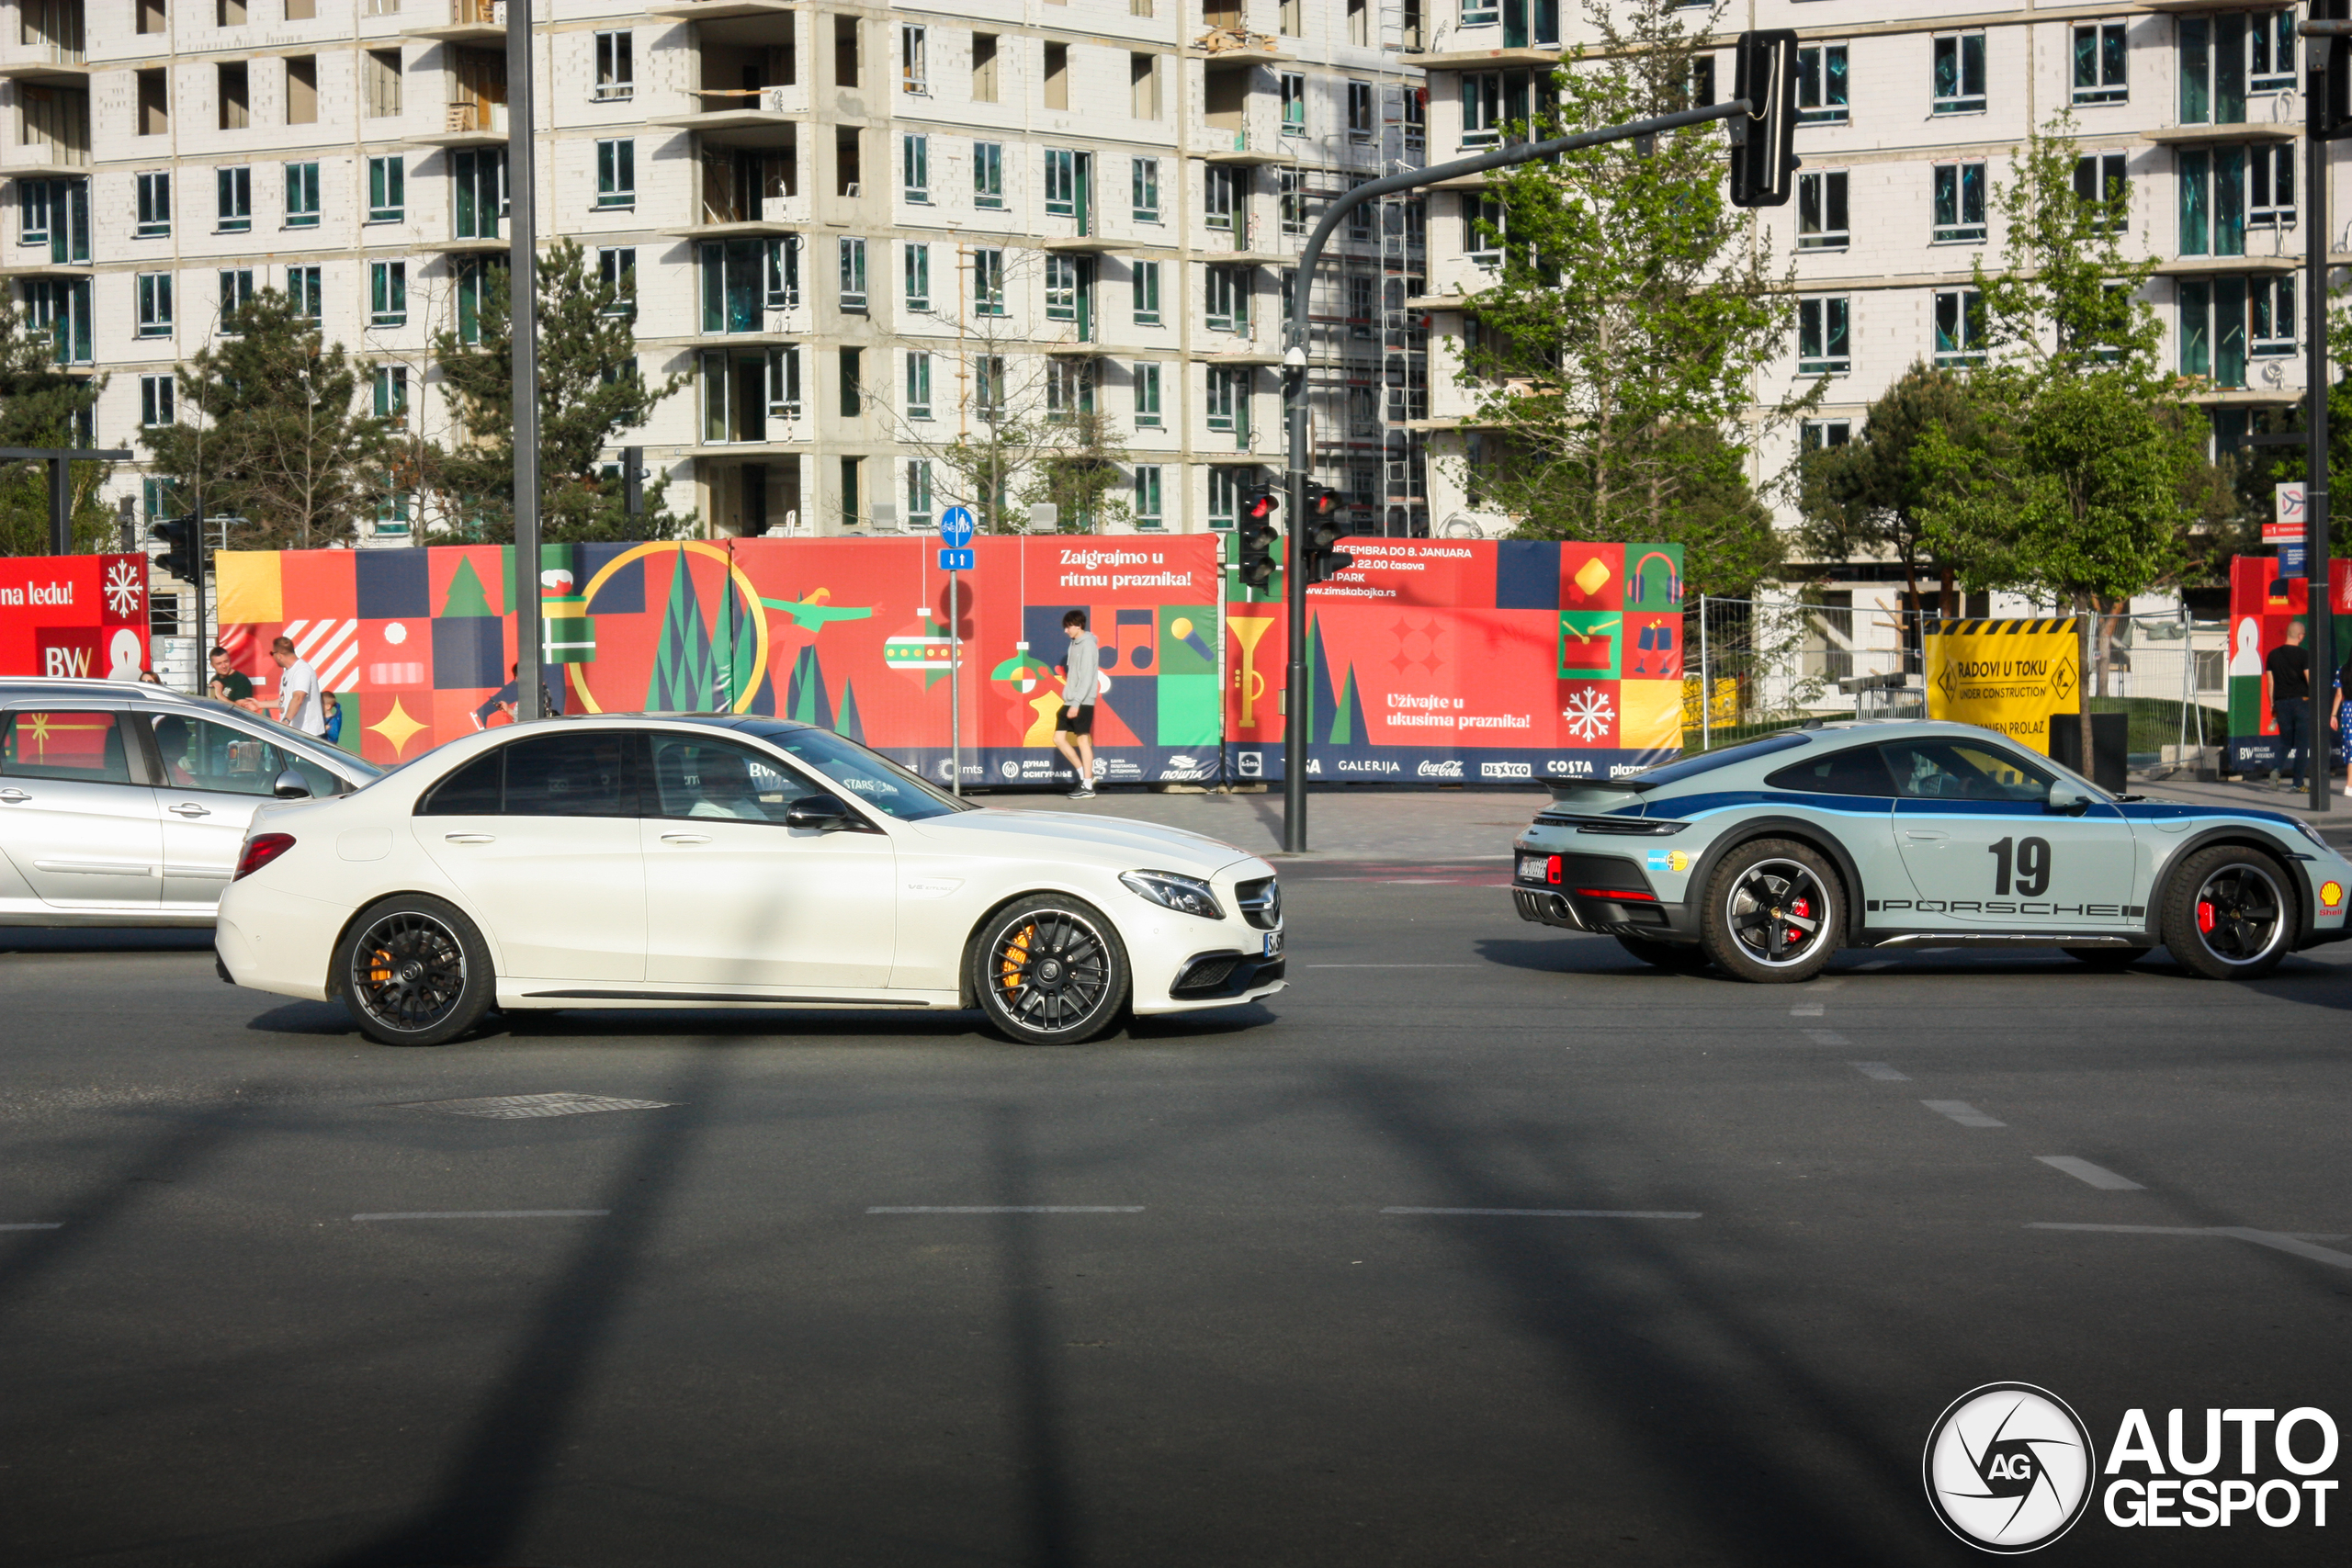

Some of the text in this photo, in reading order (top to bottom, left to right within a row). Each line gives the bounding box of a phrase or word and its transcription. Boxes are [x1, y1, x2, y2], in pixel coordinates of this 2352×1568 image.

[1060, 549, 1163, 570] Zaigrajmo u
[1389, 547, 1406, 557] DO
[1407, 547, 1418, 557] 8.
[1419, 547, 1473, 558] JANUARA
[1357, 559, 1388, 569] 22.00
[1389, 560, 1425, 570] časova
[1060, 571, 1192, 590] ritmu praznika!
[1337, 573, 1365, 581] PARK
[1, 581, 74, 605] na ledu!
[1306, 586, 1396, 599] ww.zimskabajka.rs
[45, 647, 92, 678] BW
[1958, 660, 2047, 678] RADOVI U TOKU
[1959, 686, 2047, 700] UNDER CONSTRUCTION
[1386, 694, 1464, 711] Uživajte u
[1386, 712, 1531, 730] ukusima praznika!
[1974, 720, 2044, 735] ANJEN PROLAZ
[962, 764, 983, 774] mts
[1022, 760, 1050, 769] ДУНАВ
[1338, 760, 1401, 773] GALERIJA
[1483, 762, 1530, 778] DEXYCO
[1546, 760, 1594, 774] COSTA
[1159, 770, 1204, 780] ПОШТА
[843, 778, 875, 792] STARS
[1988, 836, 2051, 897] 19
[1883, 899, 2120, 918] PORSCHE
[2319, 908, 2342, 917] Shell
